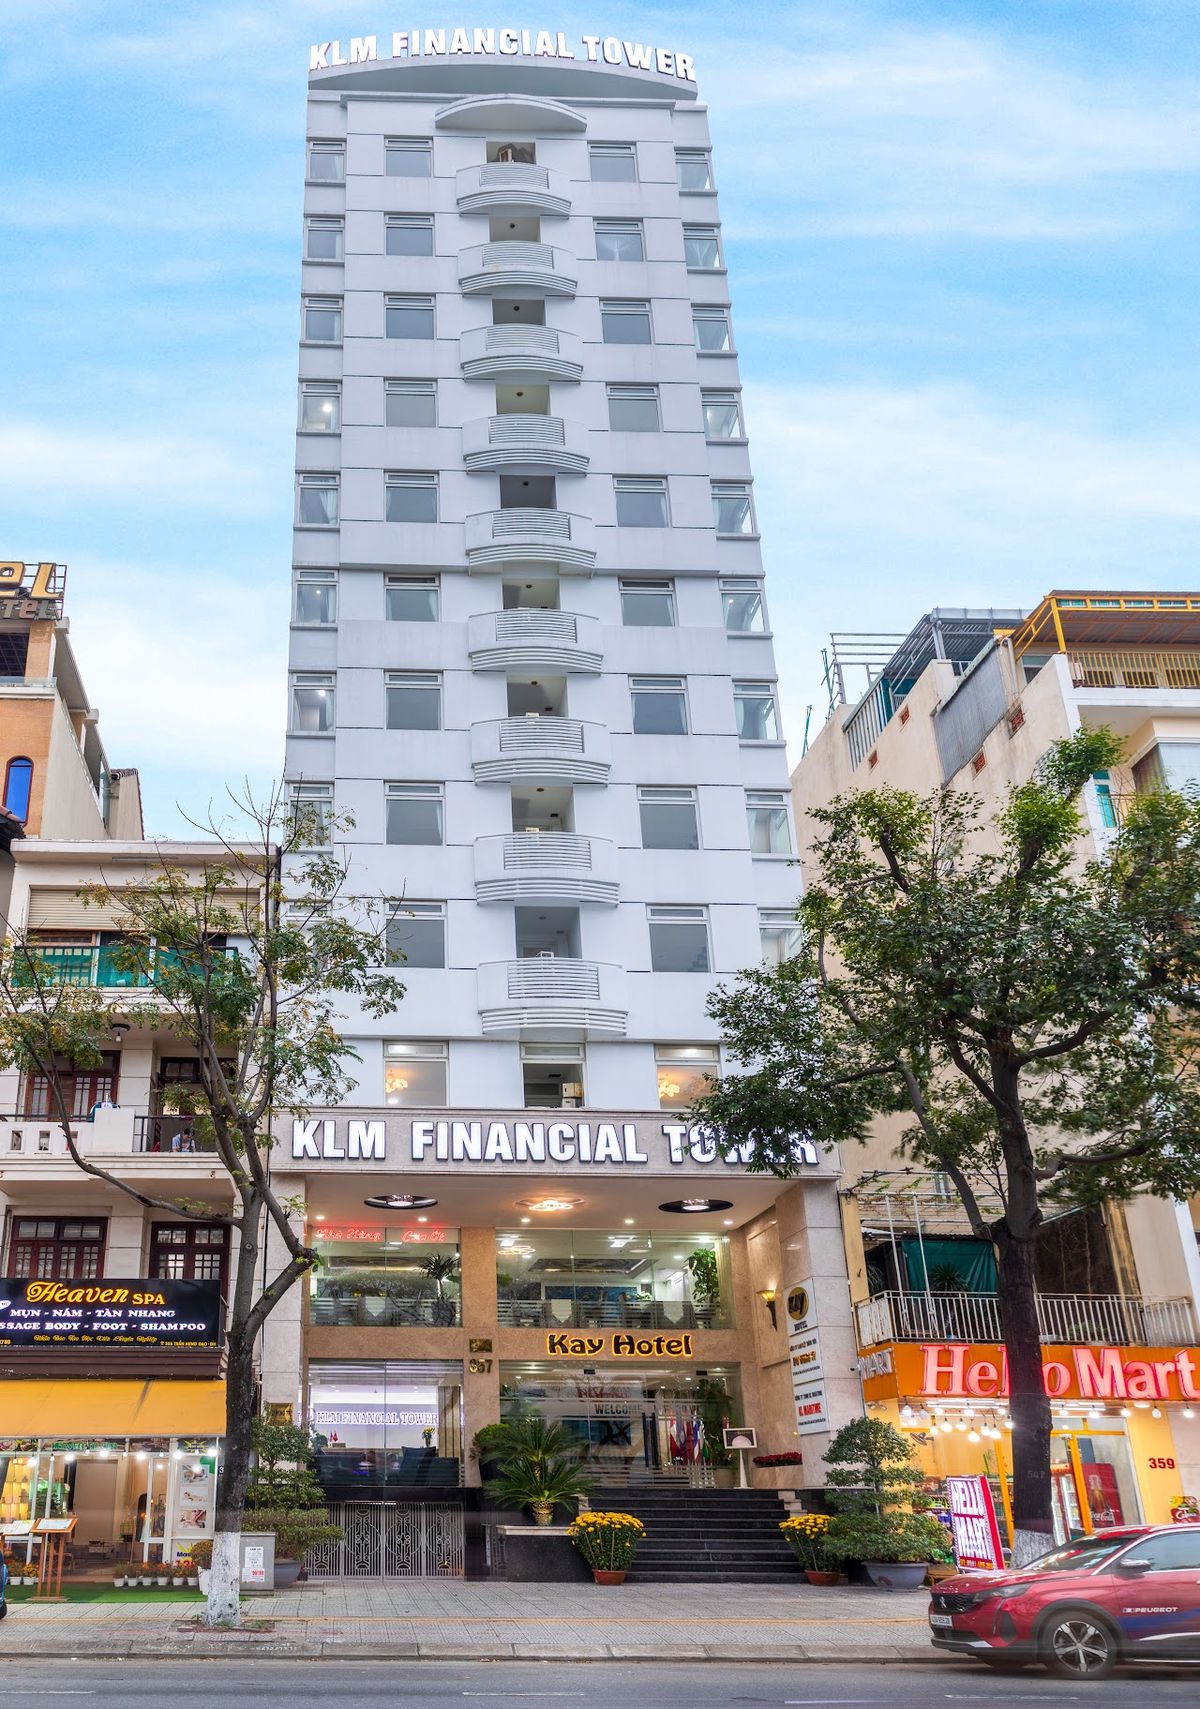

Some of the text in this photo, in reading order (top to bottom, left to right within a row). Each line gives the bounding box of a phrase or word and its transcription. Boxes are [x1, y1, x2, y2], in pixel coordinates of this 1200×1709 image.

[309, 28, 697, 82] KLM FINANCIAL TOWER
[291, 1119, 819, 1165] KLM FINANCIAL TOWR
[26, 1281, 165, 1305] Heaven SPA
[128, 1310, 176, 1318] NHANG
[45, 1322, 81, 1330] BODY
[92, 1323, 128, 1331] FOOT
[140, 1322, 206, 1331] SHAMPOO
[546, 1333, 693, 1357] Kay Hotel
[919, 1345, 1200, 1399] Helo Mart
[1148, 1458, 1175, 1469] 359
